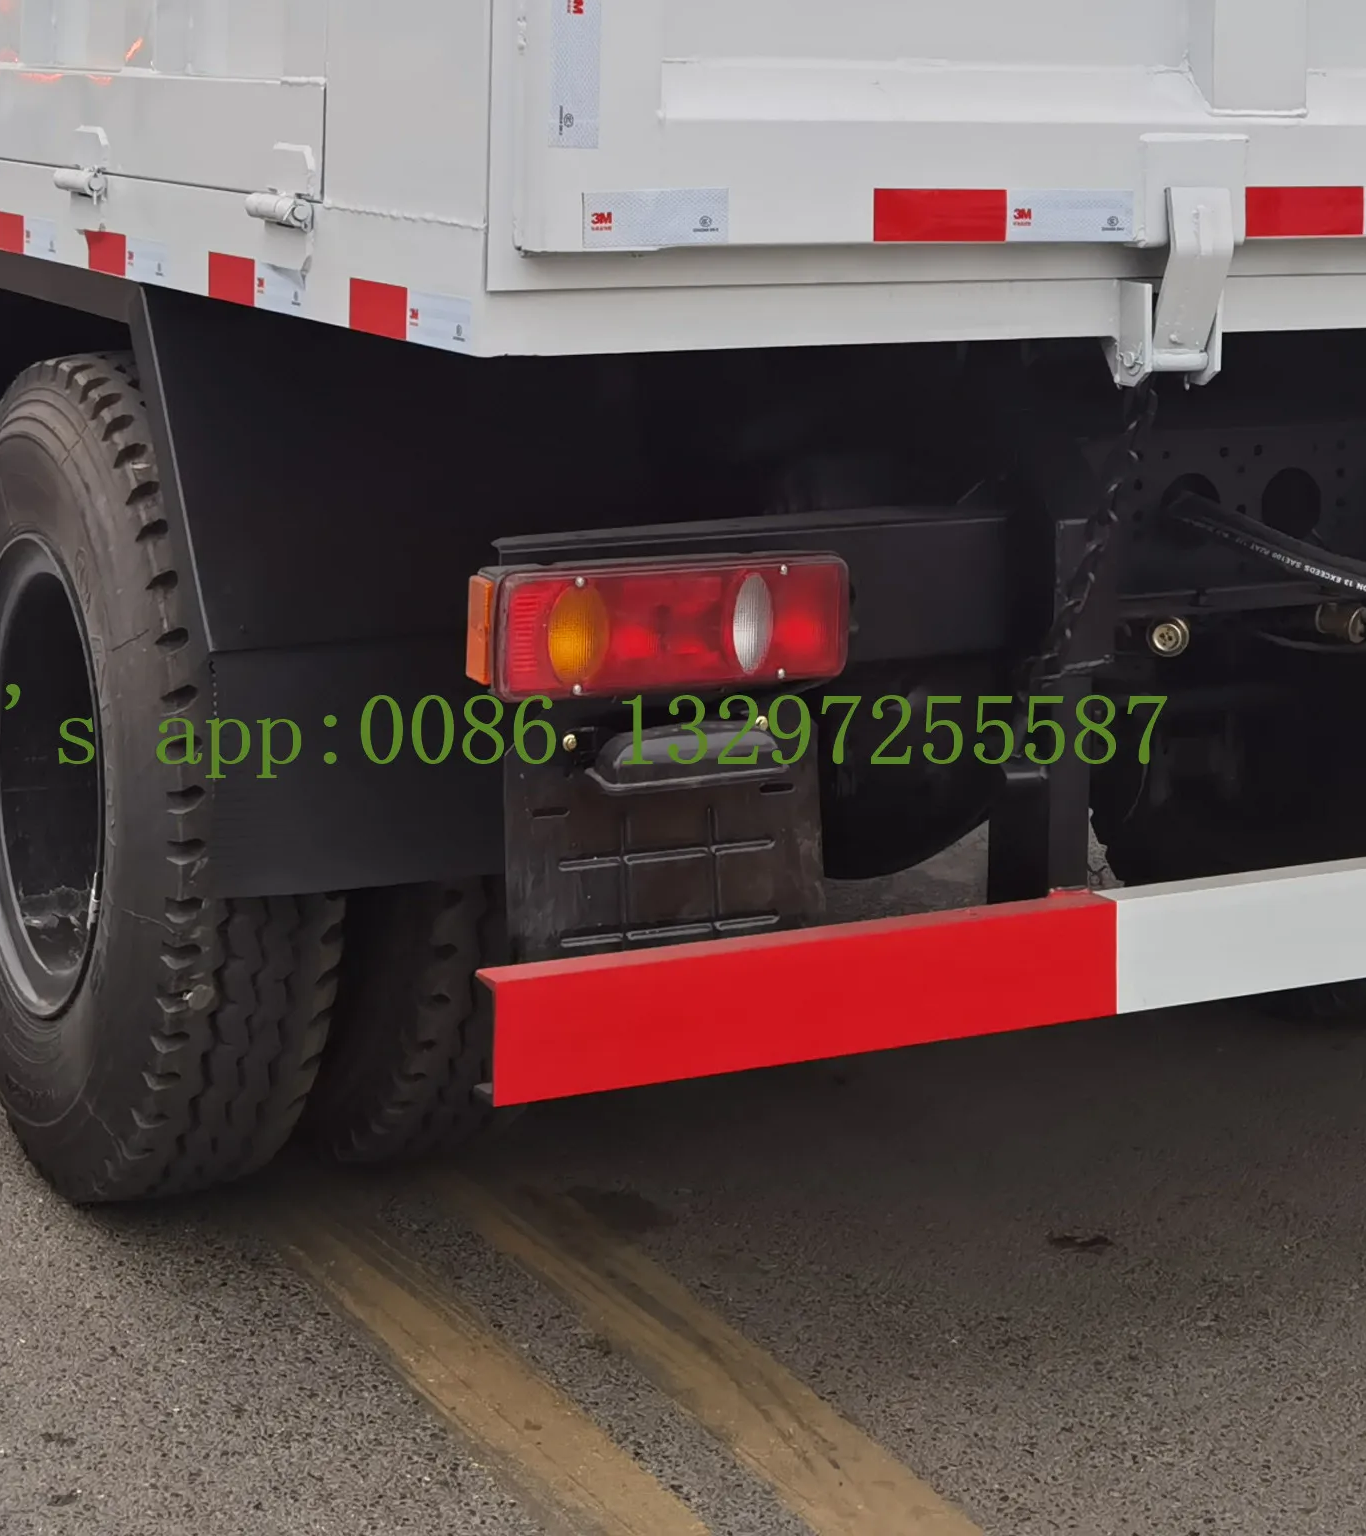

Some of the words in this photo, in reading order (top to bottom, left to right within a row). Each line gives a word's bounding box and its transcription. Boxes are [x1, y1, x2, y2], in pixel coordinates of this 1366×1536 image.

[591, 212, 613, 227] 3M
[1014, 208, 1033, 222] 3M
[1303, 564, 1342, 584] EXCEEDS
